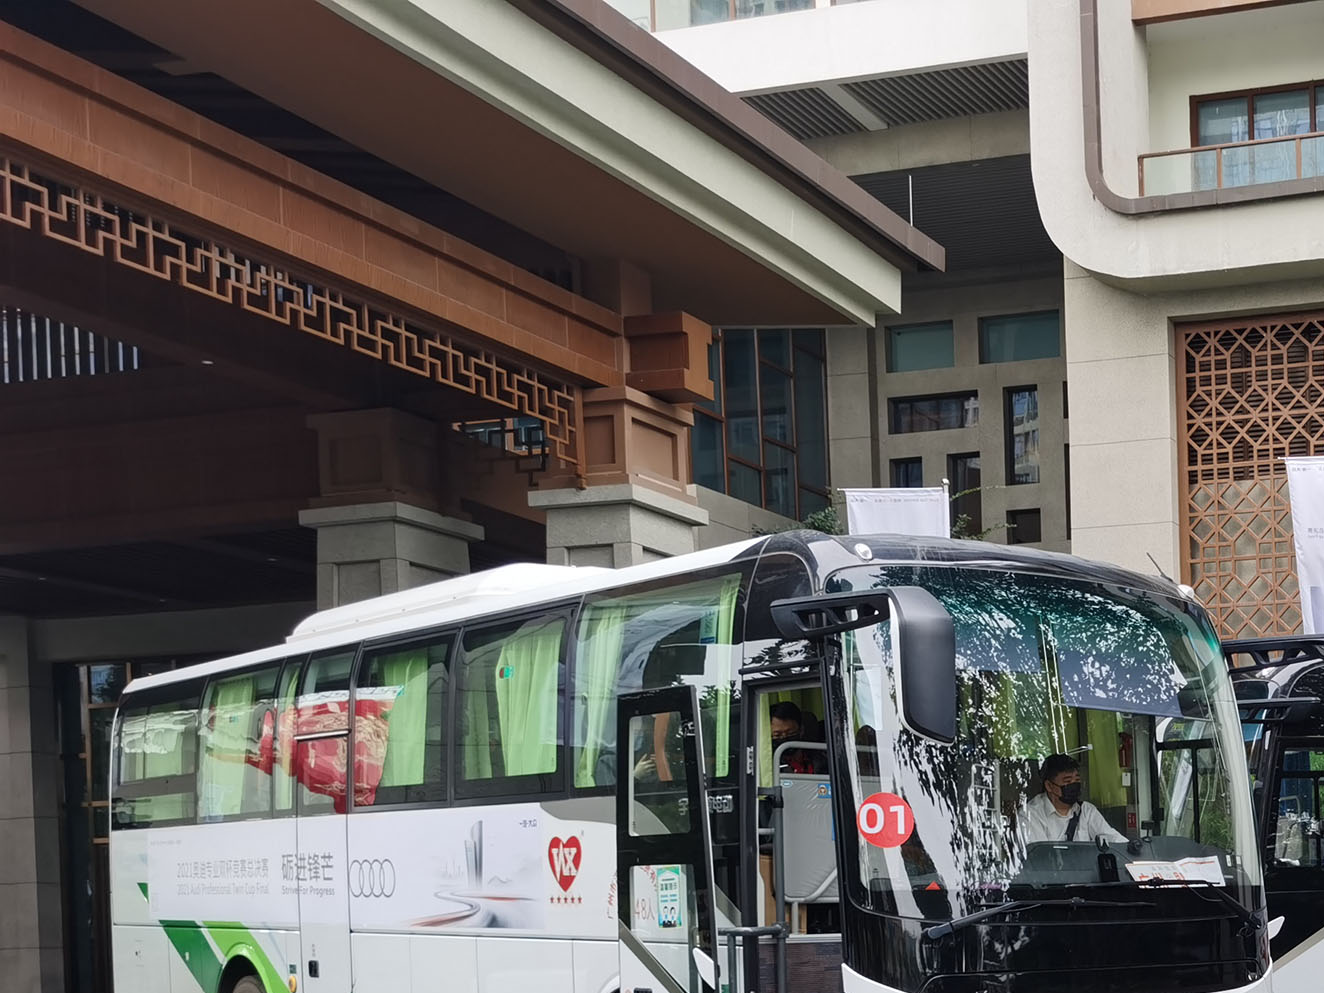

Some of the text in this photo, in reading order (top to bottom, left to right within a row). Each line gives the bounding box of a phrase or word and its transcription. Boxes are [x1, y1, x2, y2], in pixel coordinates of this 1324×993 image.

[859, 803, 905, 835] 01
[281, 852, 334, 881] 砺进锋芒
[310, 885, 335, 898] Progress
